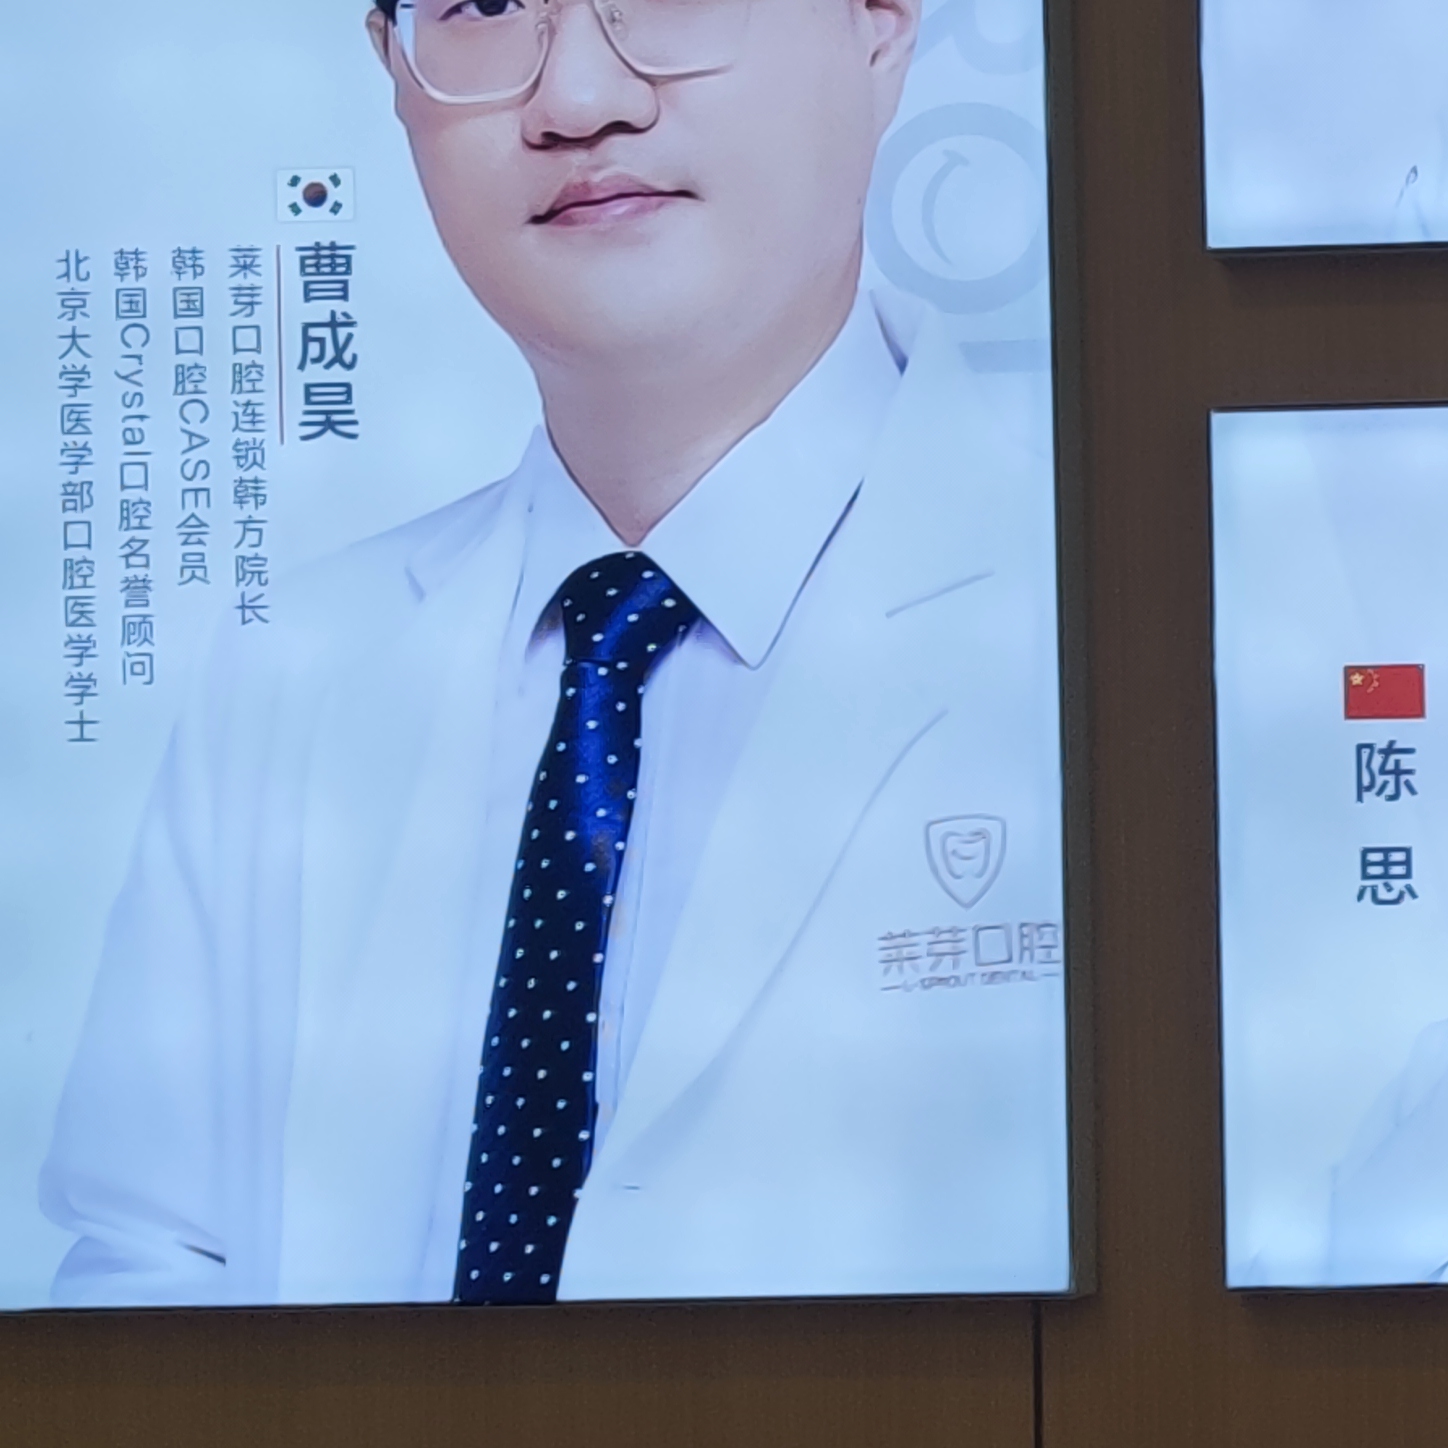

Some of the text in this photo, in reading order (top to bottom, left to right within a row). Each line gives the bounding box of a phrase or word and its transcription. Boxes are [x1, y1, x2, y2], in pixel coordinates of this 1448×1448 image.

[55, 248, 100, 743] 北京大学医学部口腔医学学士
[113, 247, 155, 686] 韩国Crystal口腔名誉顾问
[171, 245, 212, 587] 韩国口腔CASE会员
[228, 247, 271, 626] 莱芽口腔连锁韩方院长
[294, 240, 360, 442] 曹成昊
[878, 921, 1061, 976] 莱芽口腔
[1354, 739, 1420, 906] 陈思
